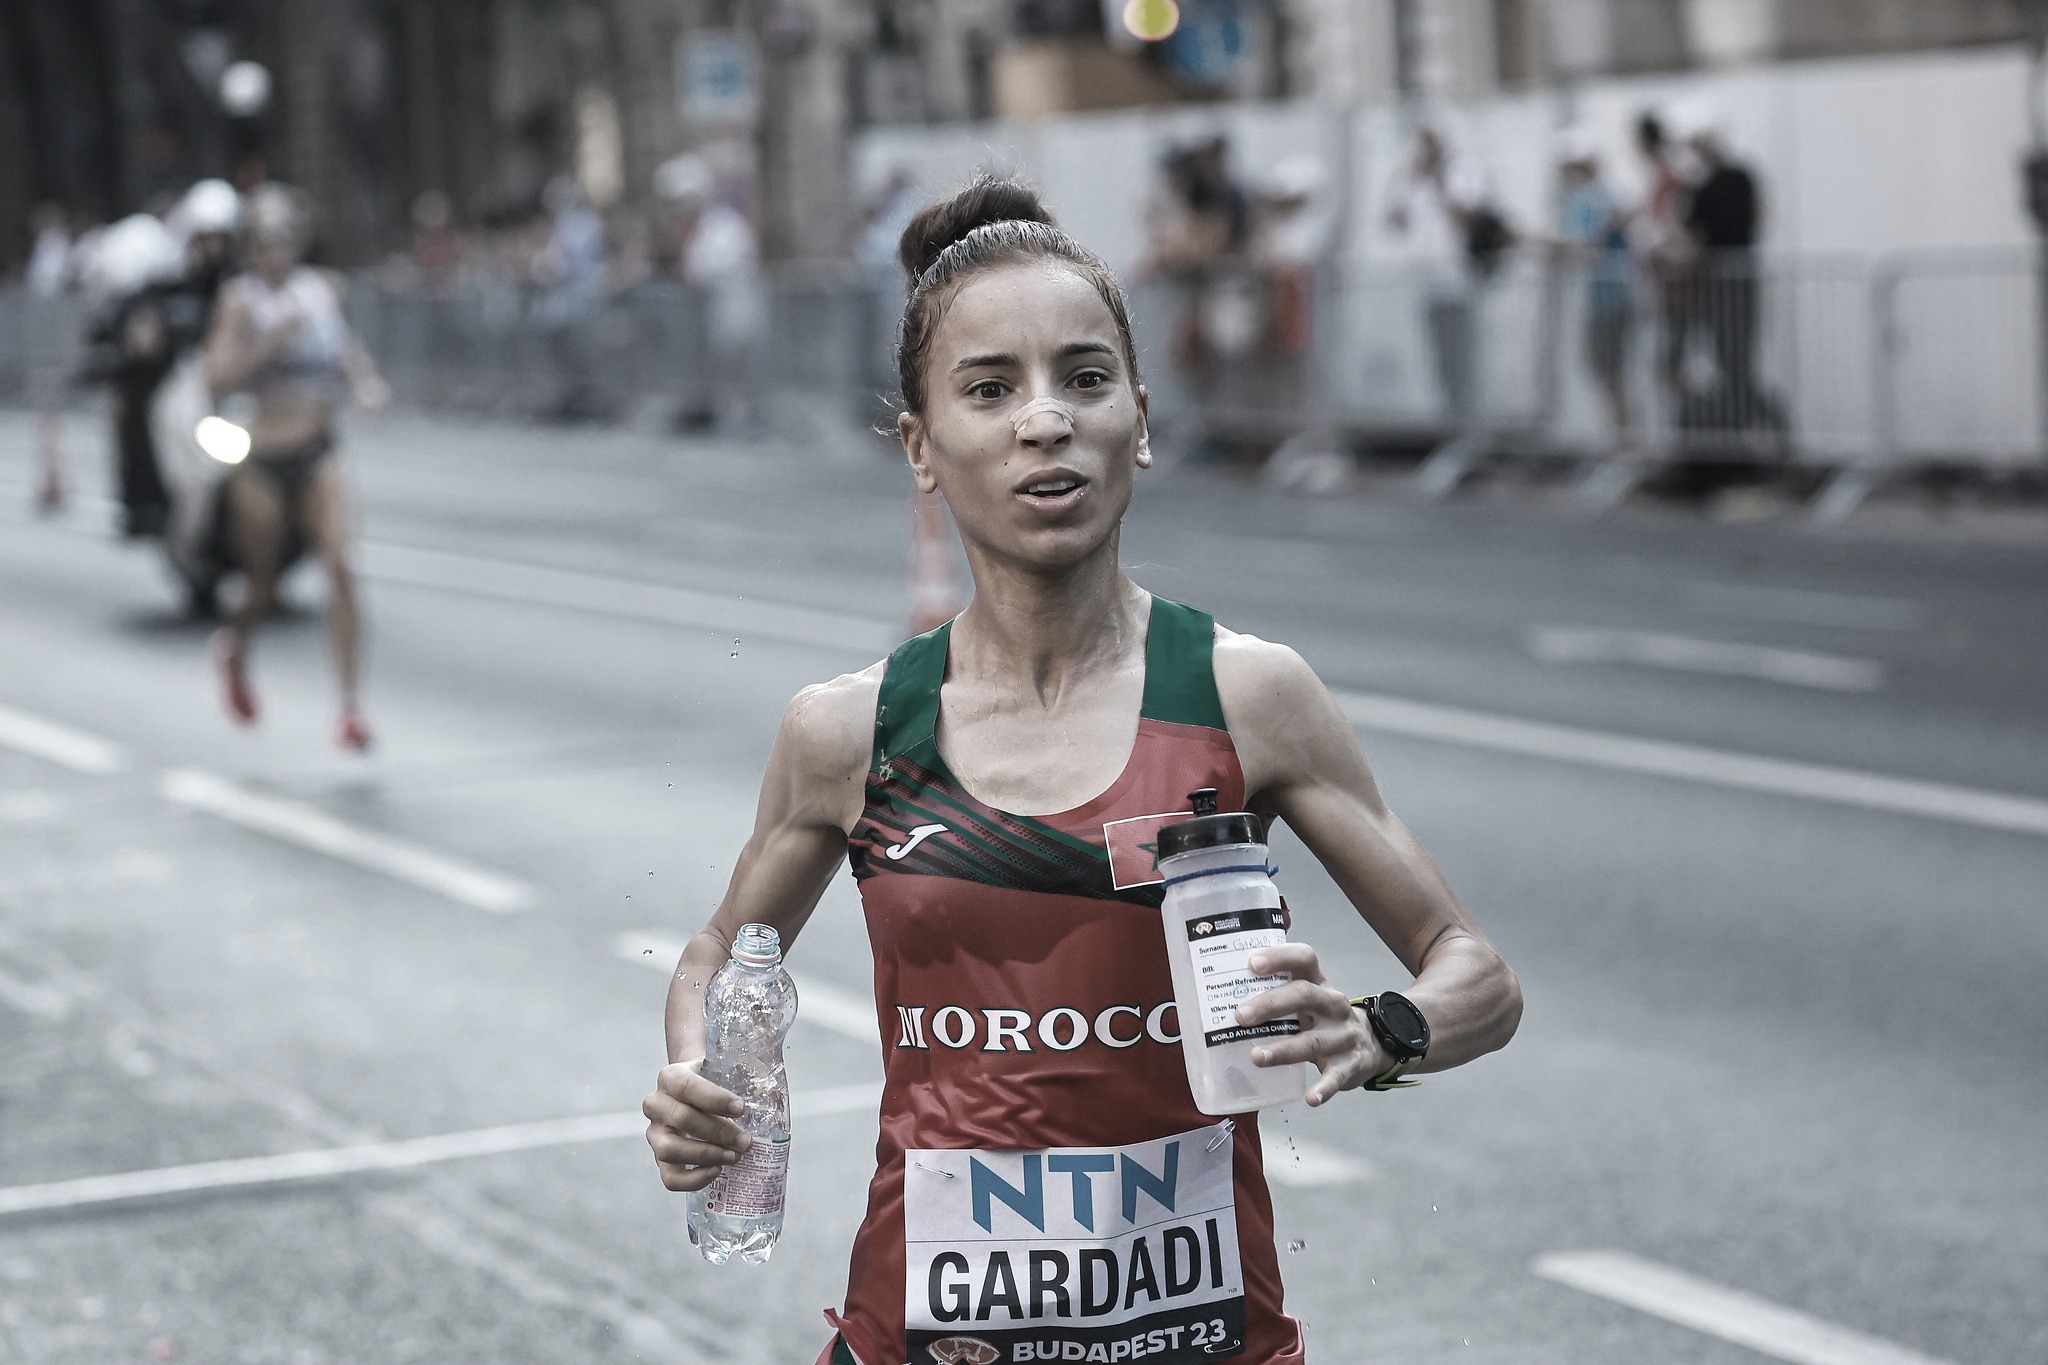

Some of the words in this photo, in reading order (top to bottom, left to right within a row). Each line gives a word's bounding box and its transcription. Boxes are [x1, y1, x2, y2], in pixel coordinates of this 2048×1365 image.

[1199, 944, 1228, 954] Surname:
[1206, 981, 1234, 991] Personal
[1235, 974, 1273, 986] Refreshment
[896, 1001, 1183, 1051] MOROCCO
[1211, 1033, 1235, 1042] WORLD
[1235, 1027, 1270, 1038] ATHLETICS
[969, 1141, 1180, 1235] NTN
[928, 1218, 1224, 1323] GARDADI
[1012, 1326, 1184, 1364] BUDAPEST
[1189, 1318, 1227, 1347] 23
